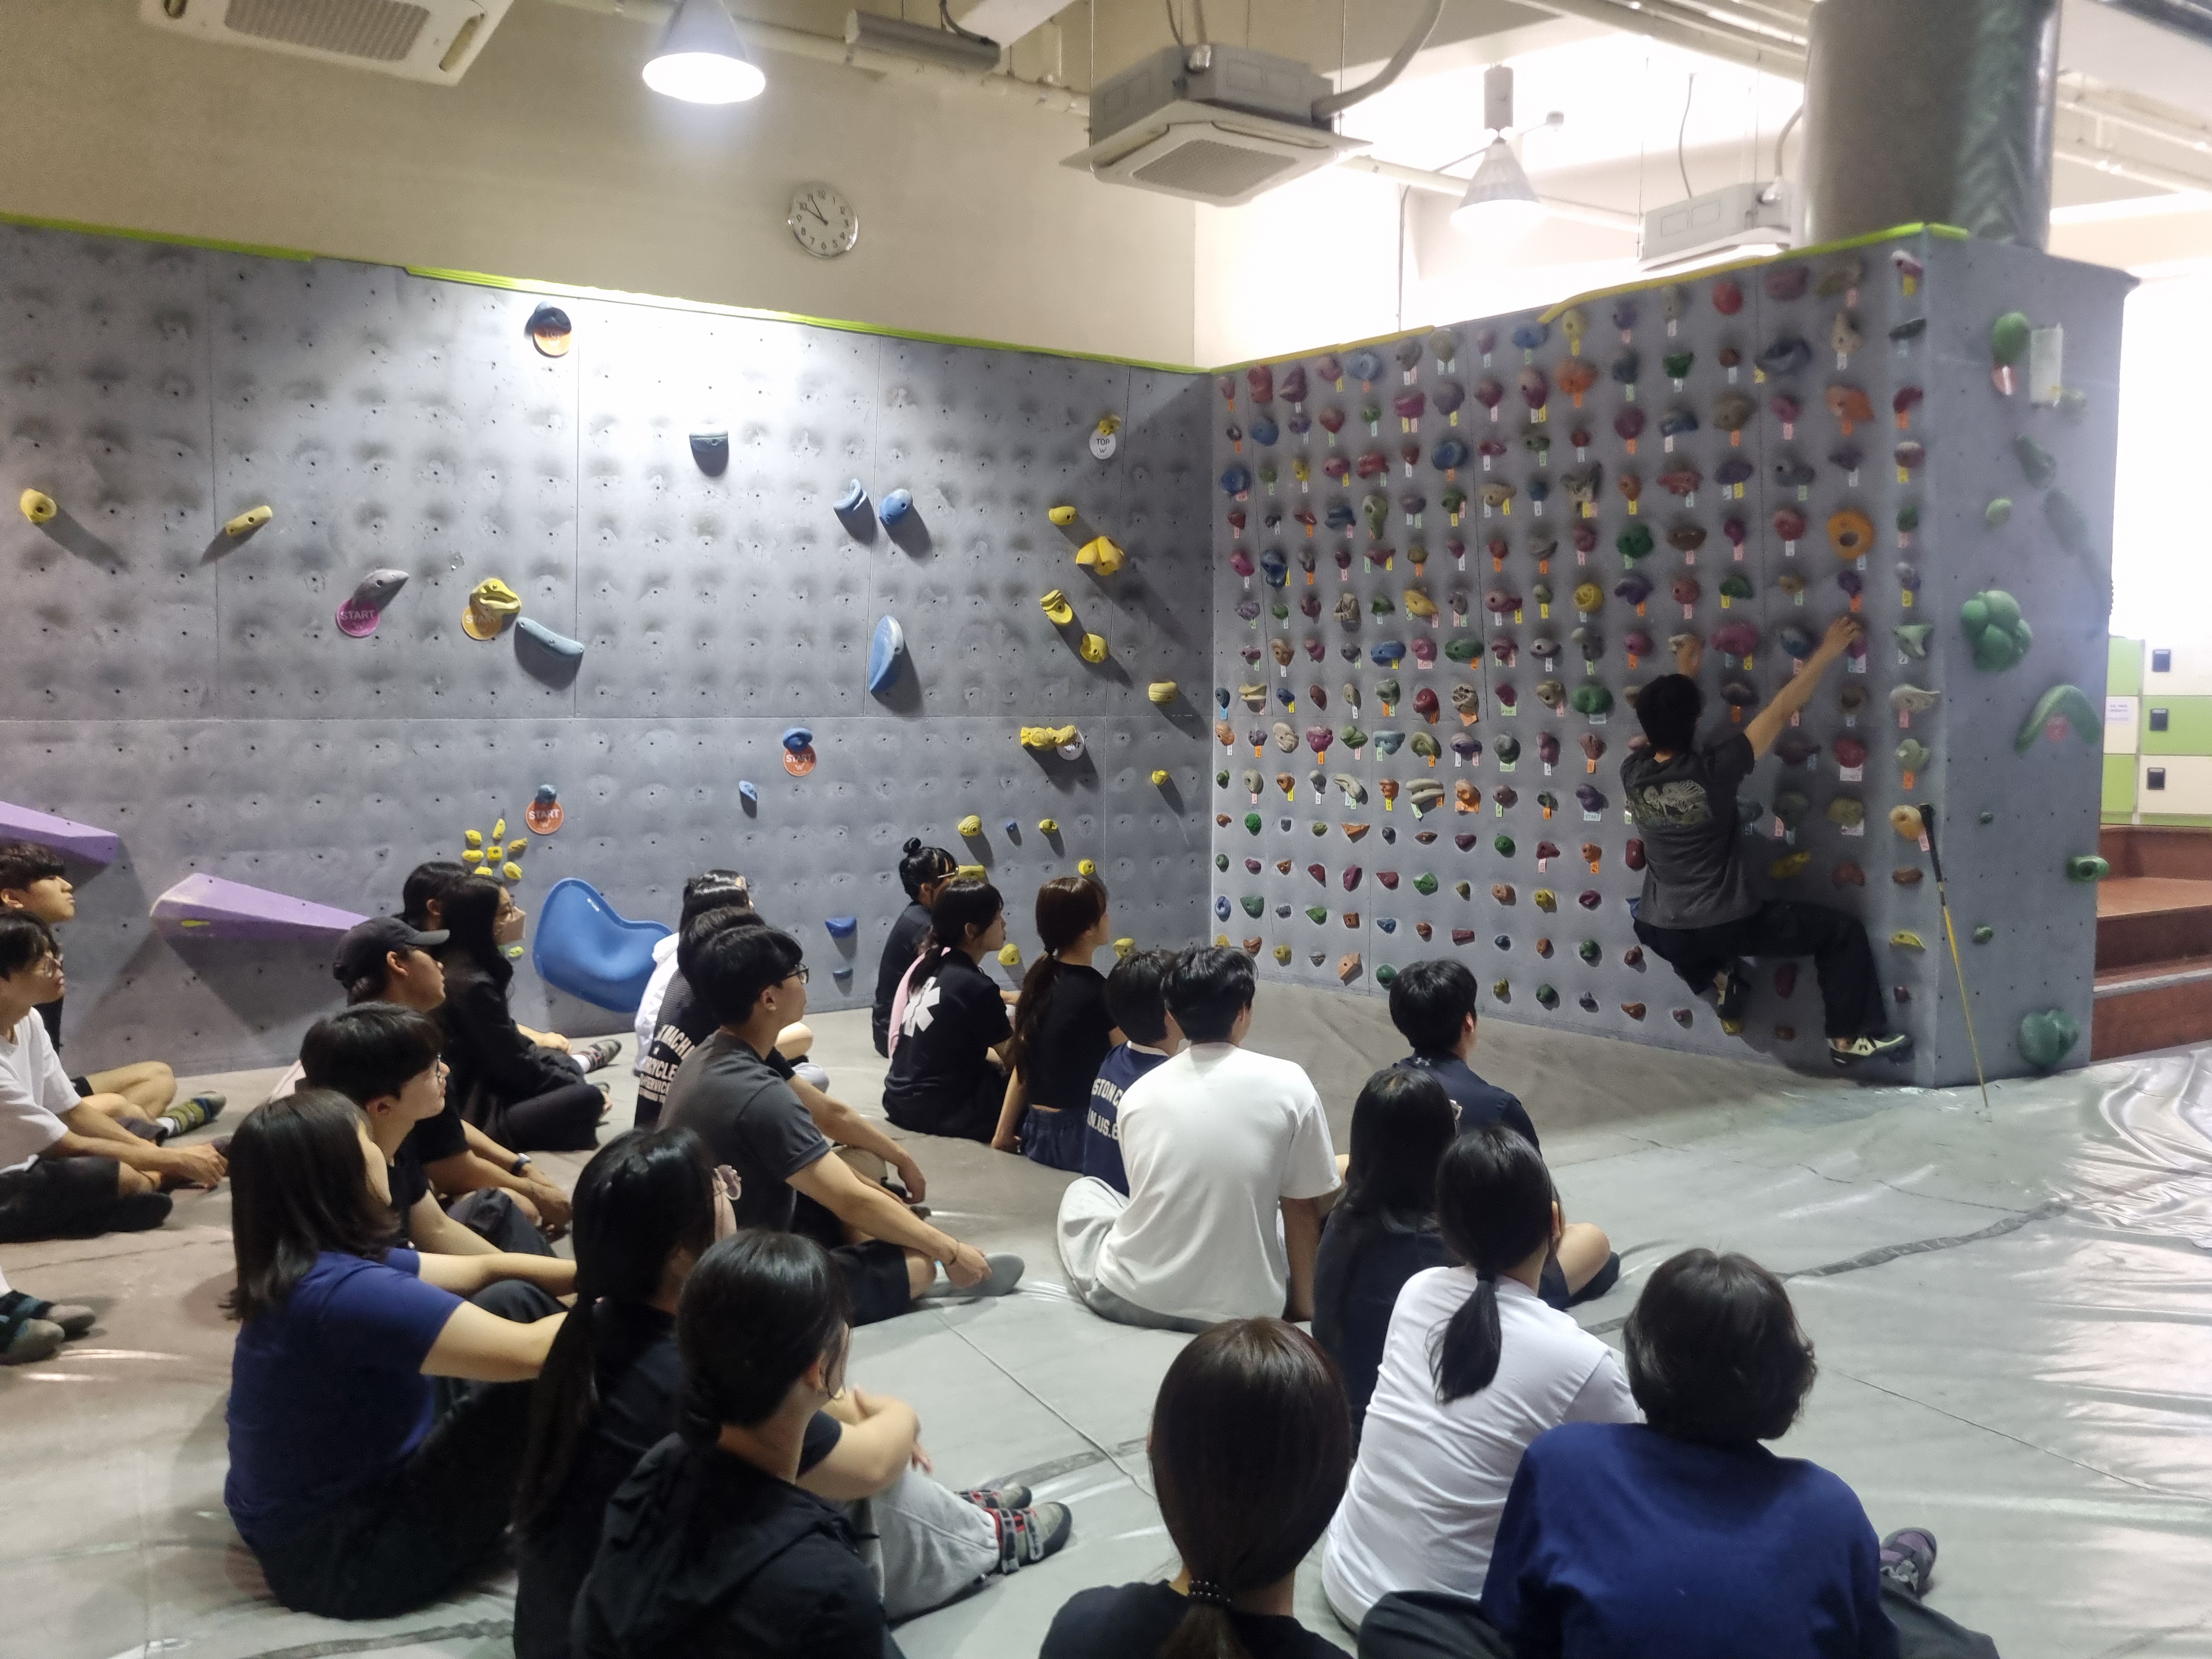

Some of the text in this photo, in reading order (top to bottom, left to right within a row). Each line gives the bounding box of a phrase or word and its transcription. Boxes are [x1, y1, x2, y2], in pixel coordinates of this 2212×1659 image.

[821, 241, 827, 250] 6
[340, 610, 376, 620] START
[786, 754, 811, 763] START
[528, 809, 560, 820] START
